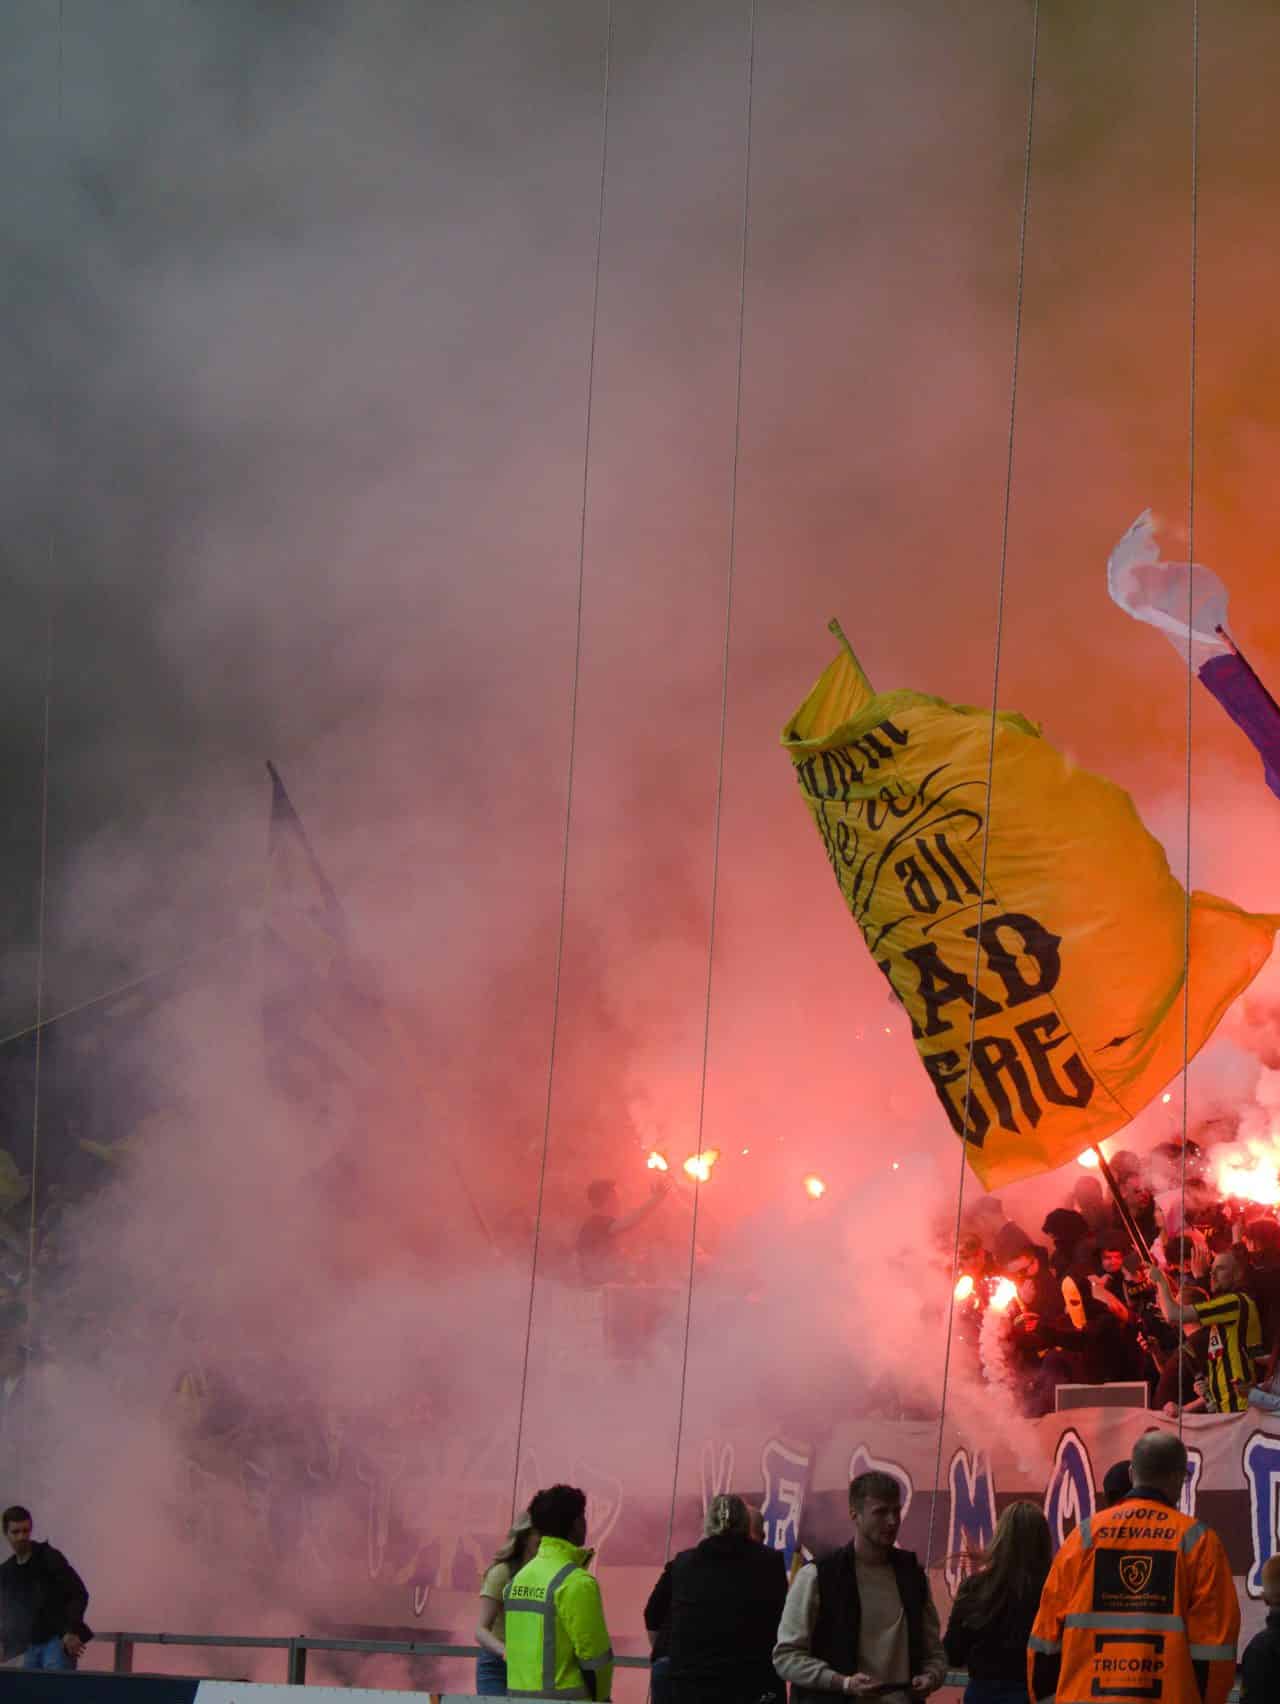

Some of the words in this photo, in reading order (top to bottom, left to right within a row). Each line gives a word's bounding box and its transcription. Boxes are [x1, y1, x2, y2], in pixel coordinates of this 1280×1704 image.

[894, 832, 983, 914] all
[877, 911, 1064, 1041] AD
[1097, 1526, 1177, 1541] STEWARD
[511, 1585, 546, 1599] SERVICE
[1092, 1658, 1166, 1673] TRICORP
